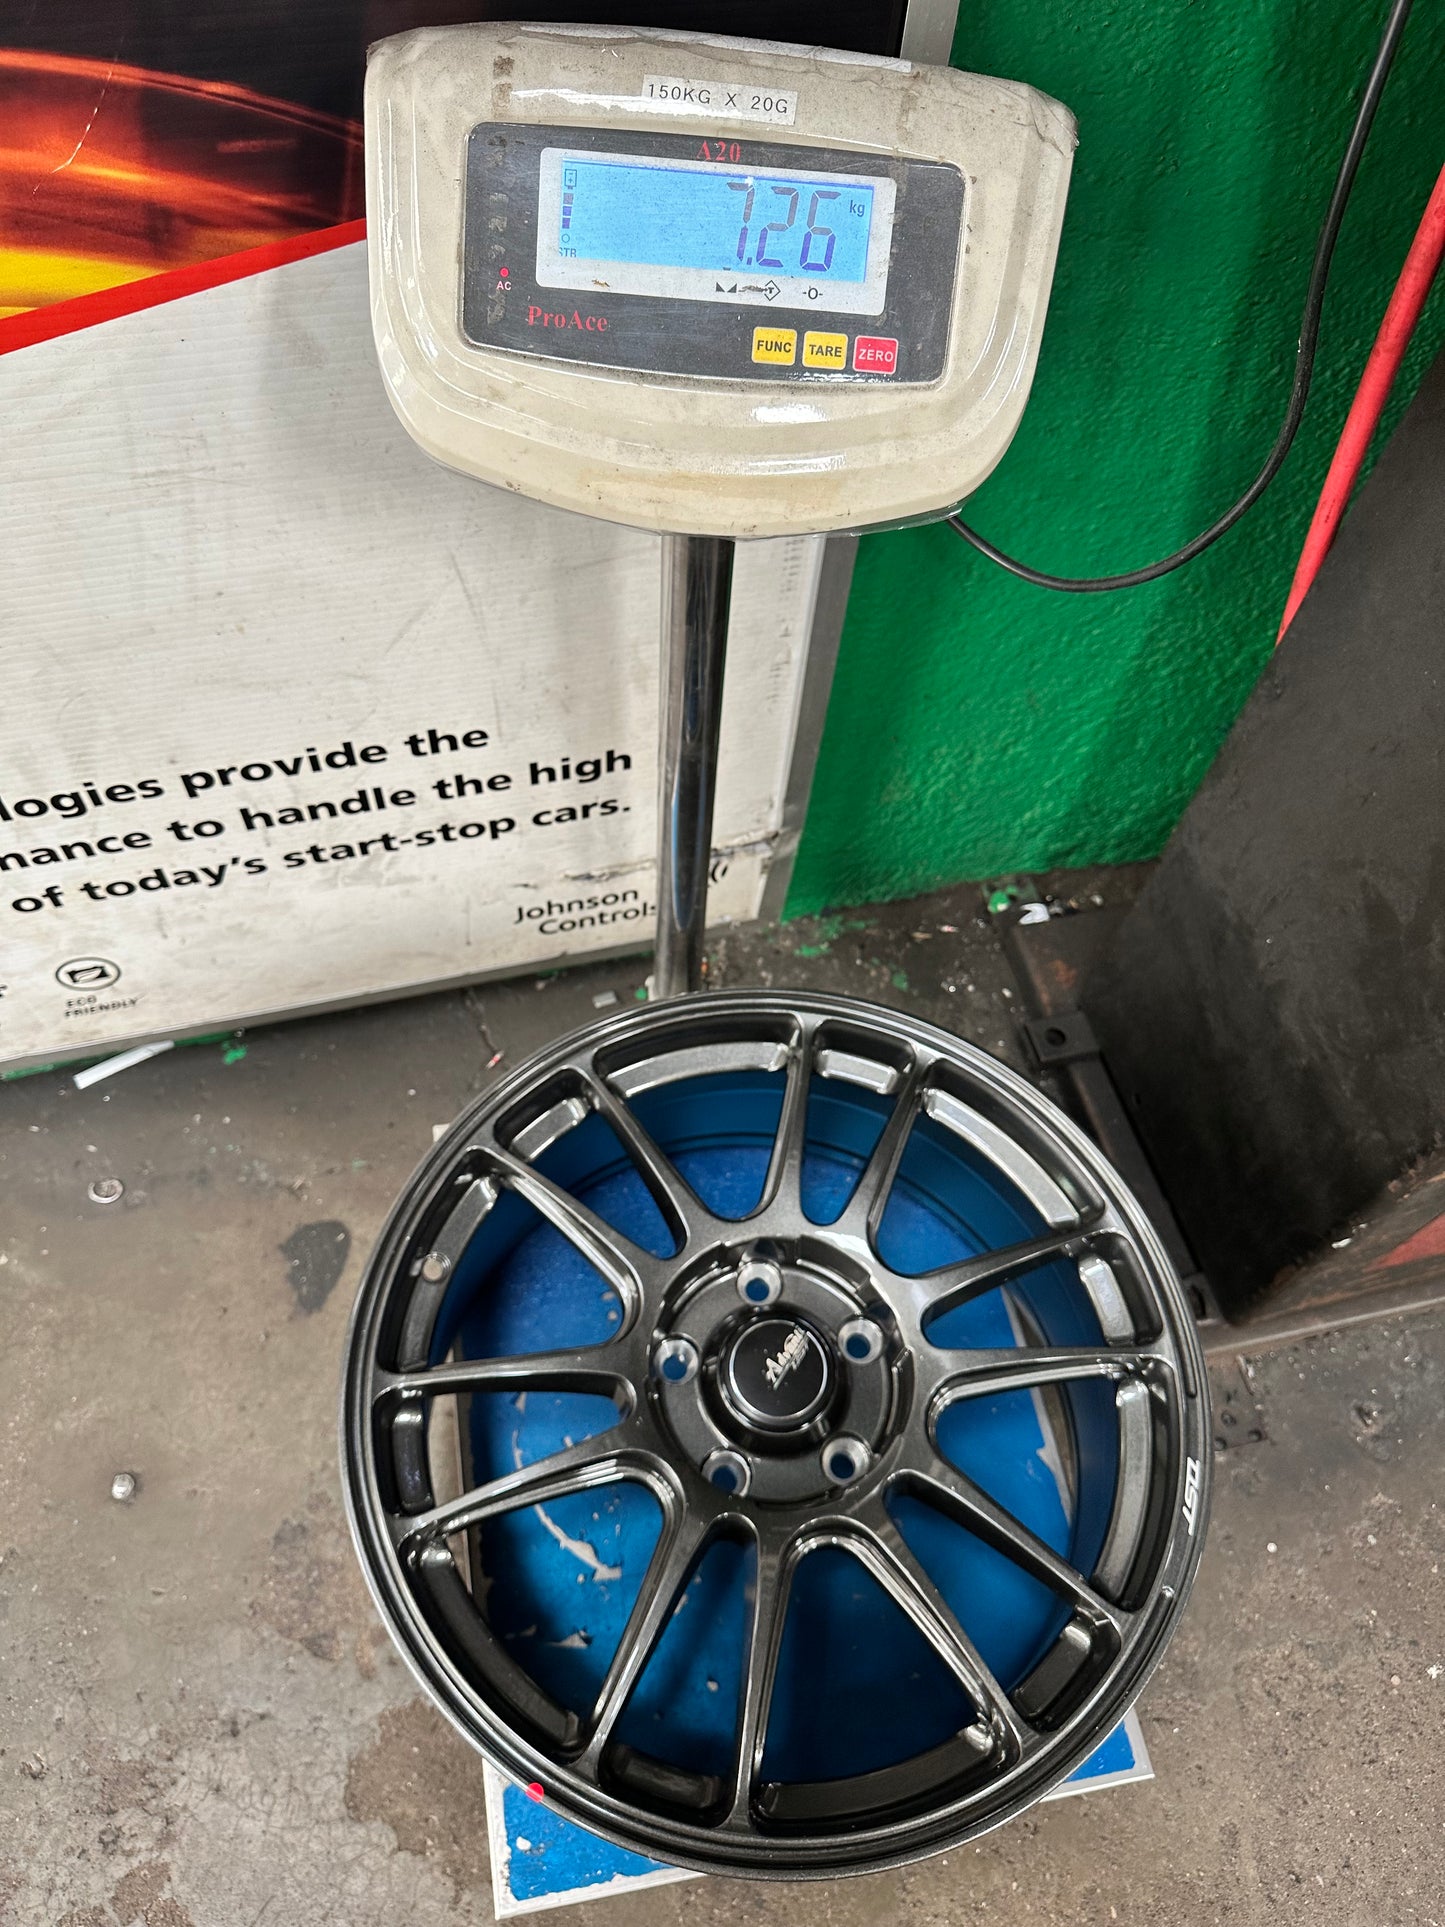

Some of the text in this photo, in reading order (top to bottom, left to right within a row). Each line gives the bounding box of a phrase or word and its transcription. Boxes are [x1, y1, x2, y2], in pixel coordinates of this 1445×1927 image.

[648, 83, 788, 114] 150KG X 20G
[696, 140, 741, 163] A20
[726, 181, 866, 272] 7.26 kg
[495, 280, 512, 292] AC
[527, 305, 609, 332] ProAce
[756, 339, 792, 354] FUNC
[808, 343, 843, 359] TARE
[857, 348, 895, 363] ZERO
[181, 741, 389, 798] provide
[404, 728, 490, 758] the
[166, 819, 225, 842] to
[239, 787, 417, 831] handle
[432, 773, 512, 801] the
[529, 750, 632, 783] high
[12, 885, 64, 913] of
[283, 817, 516, 868] start-stop
[531, 799, 631, 827] cars.
[514, 889, 639, 924] Johnson
[64, 998, 139, 1018] FRIENDLY
[66, 994, 98, 1008] ECO
